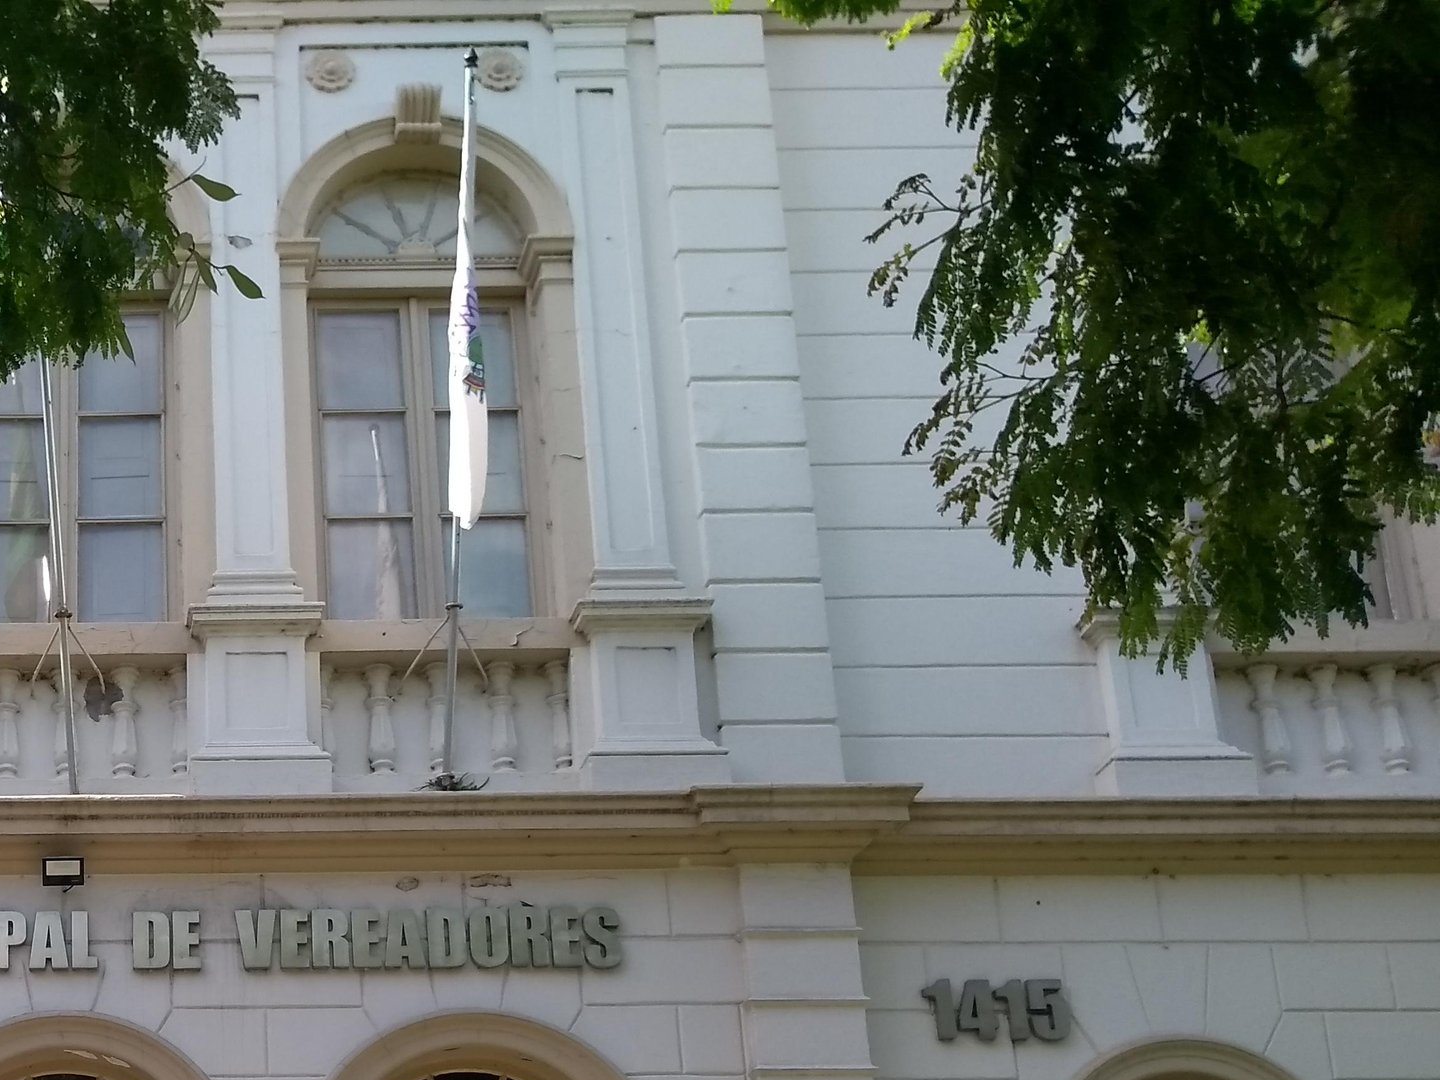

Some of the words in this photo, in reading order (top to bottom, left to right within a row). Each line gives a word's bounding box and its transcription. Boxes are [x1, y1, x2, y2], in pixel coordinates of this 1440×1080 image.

[132, 909, 201, 970] DE
[235, 906, 622, 971] VEREADORES
[921, 978, 1071, 1041] 1415
